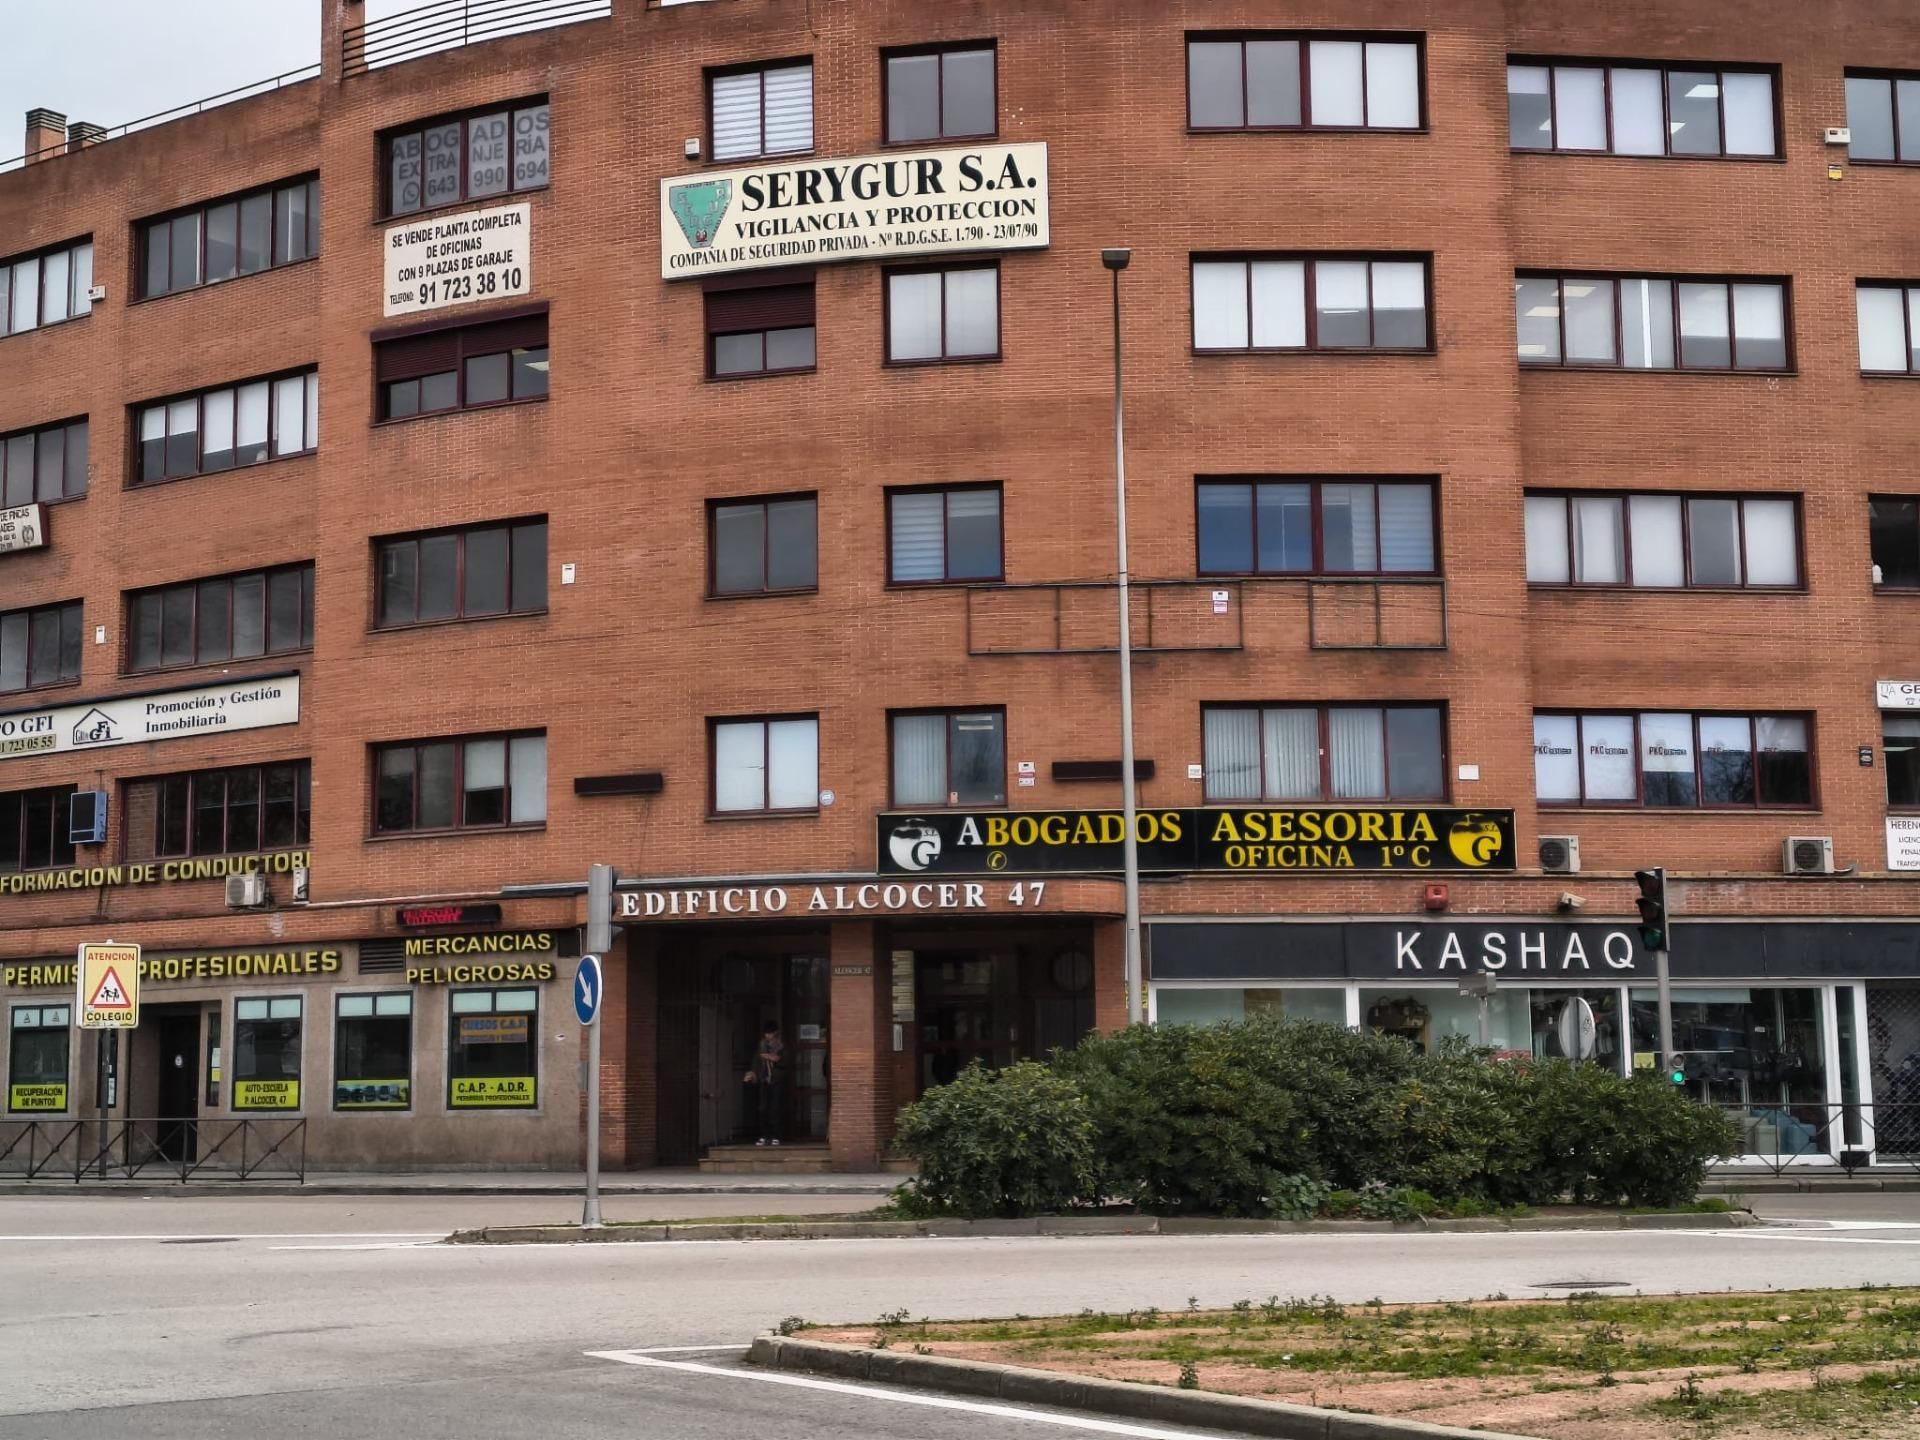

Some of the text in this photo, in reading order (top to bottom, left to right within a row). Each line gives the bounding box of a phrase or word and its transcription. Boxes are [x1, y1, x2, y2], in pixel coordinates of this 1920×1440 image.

[428, 158, 547, 196] 643 990 694
[741, 153, 1037, 212] SERYGUR S.A.
[392, 212, 522, 248] SE VENDE PLANTA COMPLETA
[735, 210, 859, 239] VIGILANCIA
[866, 209, 880, 227] Y
[886, 198, 1037, 225] PROTECCION
[426, 237, 482, 259] DE OFICINAS
[670, 246, 727, 268] COMPAÑIA
[731, 247, 746, 262] DE
[749, 238, 817, 261] SEGURIDAD
[819, 234, 869, 252] PRIVADA
[879, 233, 893, 247] Nº
[895, 228, 952, 247] R.D.G.S.E.
[955, 225, 984, 242] 1.790
[994, 222, 1038, 240] 23/07/90
[398, 249, 513, 282] CON 9 PLAZAS DE GARAJE
[420, 280, 436, 305] 91
[442, 275, 472, 301] 723
[476, 271, 496, 295] 38
[502, 267, 522, 291] 10
[146, 687, 281, 715] Promoción y Gestión
[0, 715, 54, 736] O GFI
[146, 712, 227, 733] Inmobiliaria
[9, 740, 24, 751] 723
[27, 738, 39, 749] 05
[41, 736, 53, 748] 55
[1590, 745, 1604, 755] PKC
[1649, 746, 1663, 756] PKC
[957, 812, 1438, 847] ABOGADOS ASESORIA
[911, 840, 938, 867] G
[1225, 845, 1355, 868] OFICINA
[1411, 845, 1432, 867] C
[1471, 835, 1500, 863] G
[0, 866, 122, 893] FORMACION
[129, 863, 156, 883] DE
[620, 881, 1046, 917] EDIFICIO ALCOCER 47
[88, 952, 135, 961] ATENCION
[405, 933, 551, 956] MERCANCIAS
[1396, 931, 1635, 970] KASHAQ
[139, 950, 338, 980] PROFESIONALES
[406, 963, 552, 984] PELIGROSAS
[86, 1012, 133, 1021] COLEGIO
[280, 1096, 287, 1104] 47
[458, 1082, 487, 1093] C.A.P.
[497, 1081, 528, 1092] A.D.R.
[22, 1097, 56, 1106] DE PUNTOS
